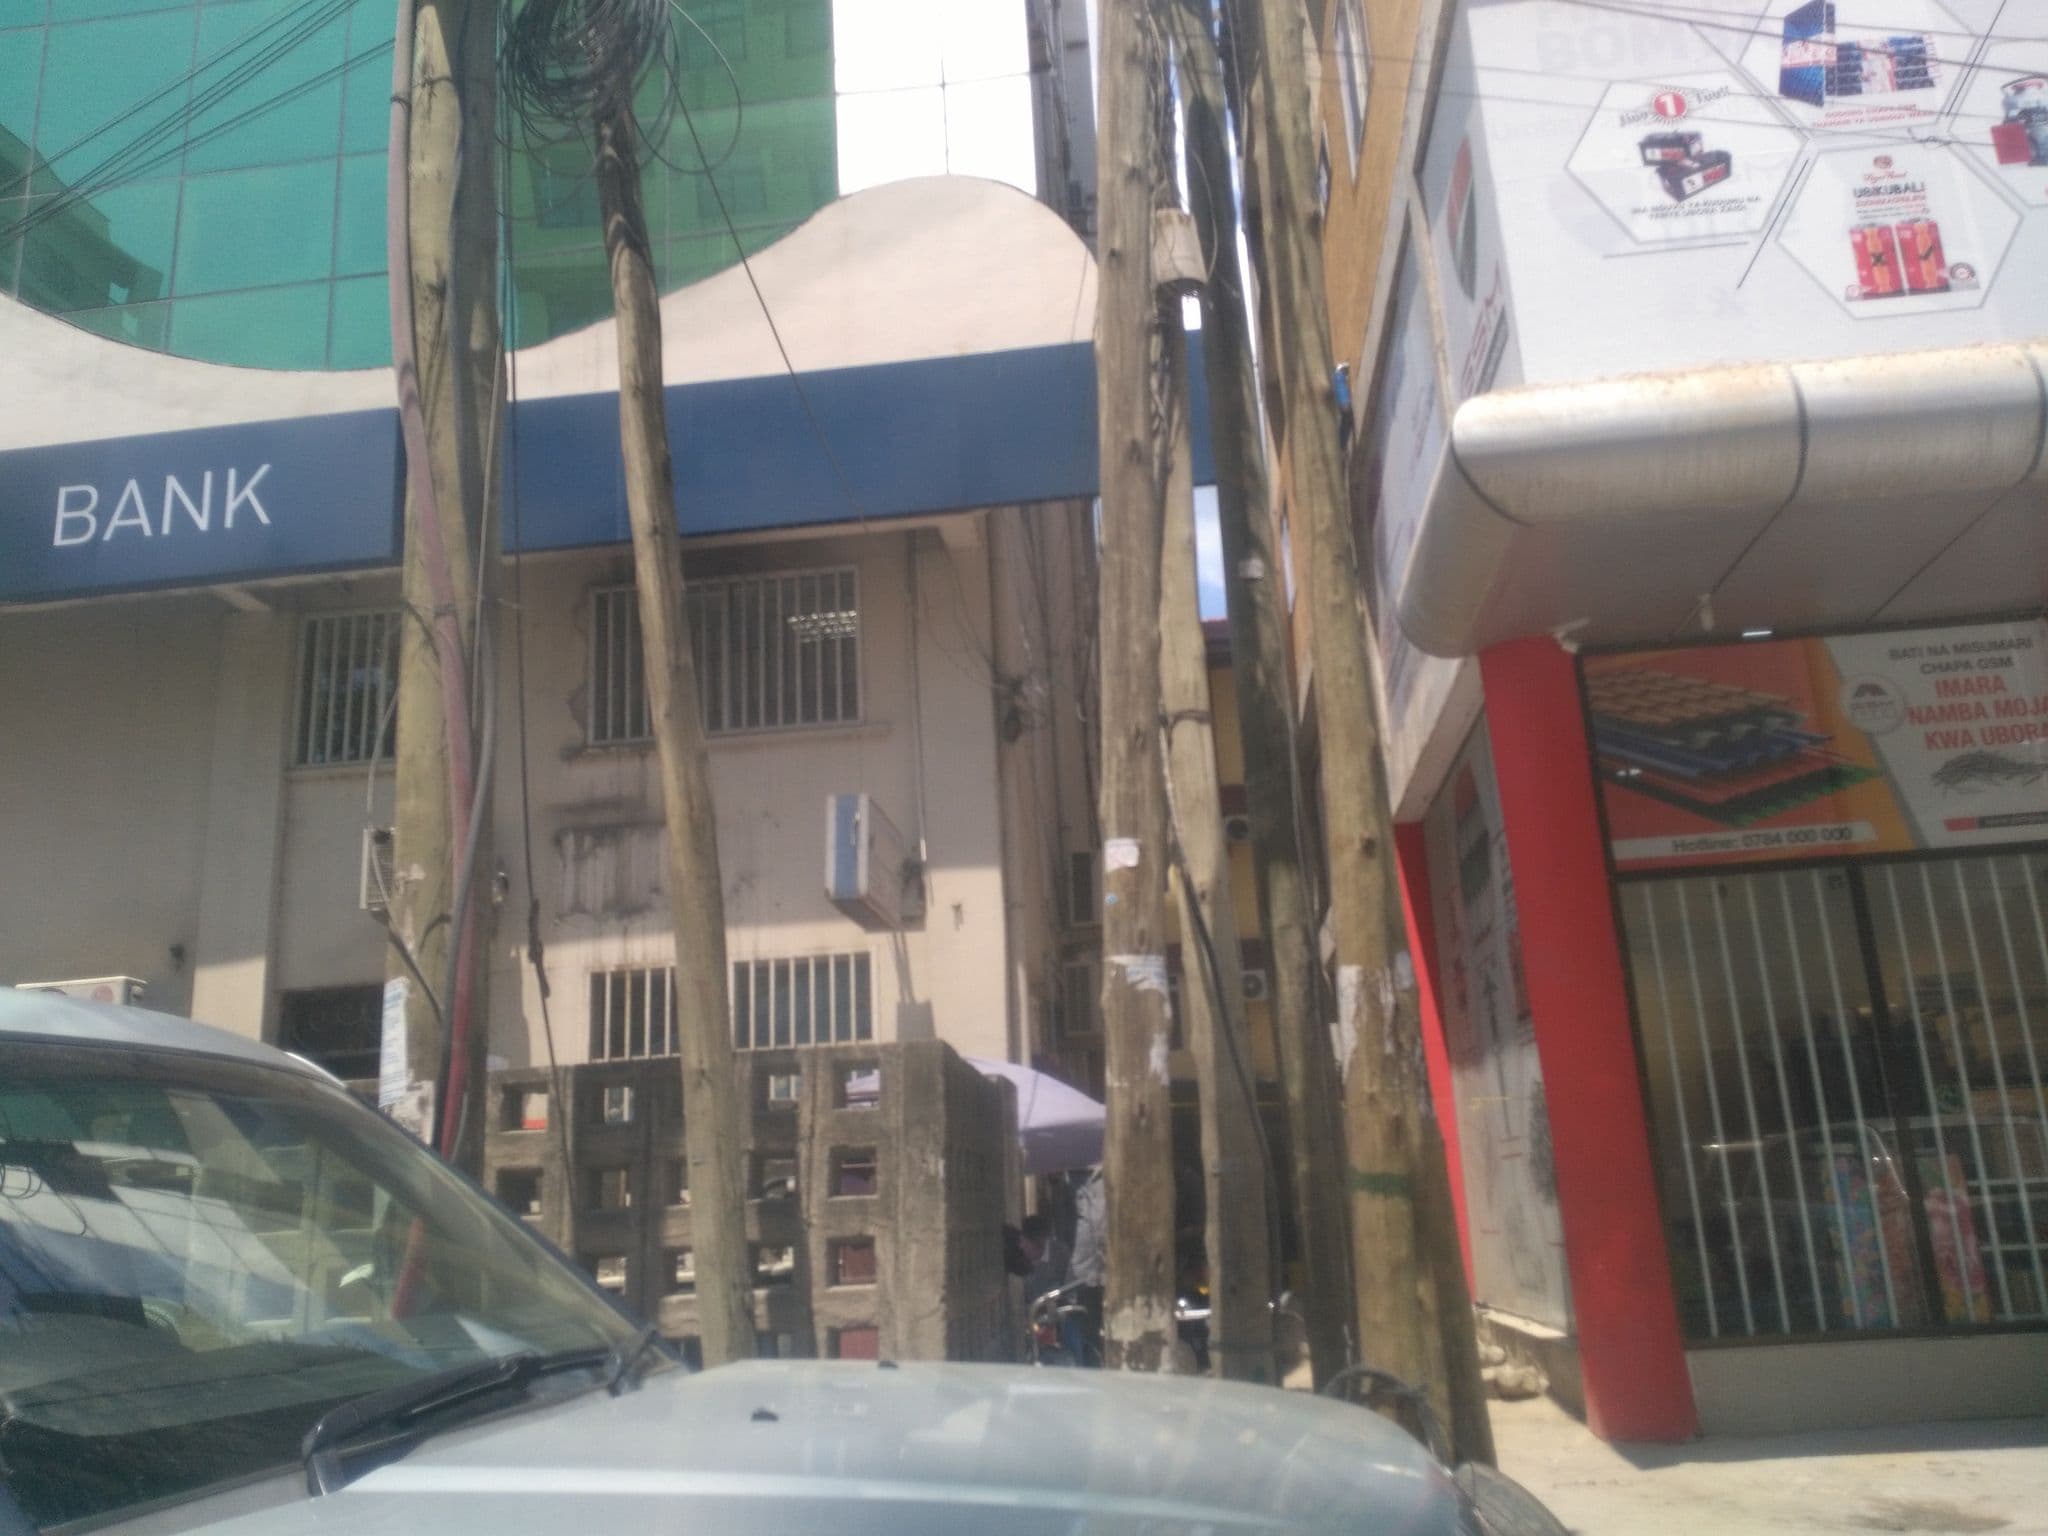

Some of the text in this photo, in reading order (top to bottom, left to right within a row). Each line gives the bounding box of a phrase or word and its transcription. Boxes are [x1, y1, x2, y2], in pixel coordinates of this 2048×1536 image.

[53, 463, 271, 546] BANK
[1927, 644, 1950, 657] NA
[1952, 637, 2033, 654] MISUMARI
[1920, 656, 2014, 675] CHAPA GSM
[1935, 675, 2008, 698] IMARA
[1909, 701, 1988, 726] NAMBA
[1924, 728, 1976, 750] KWA
